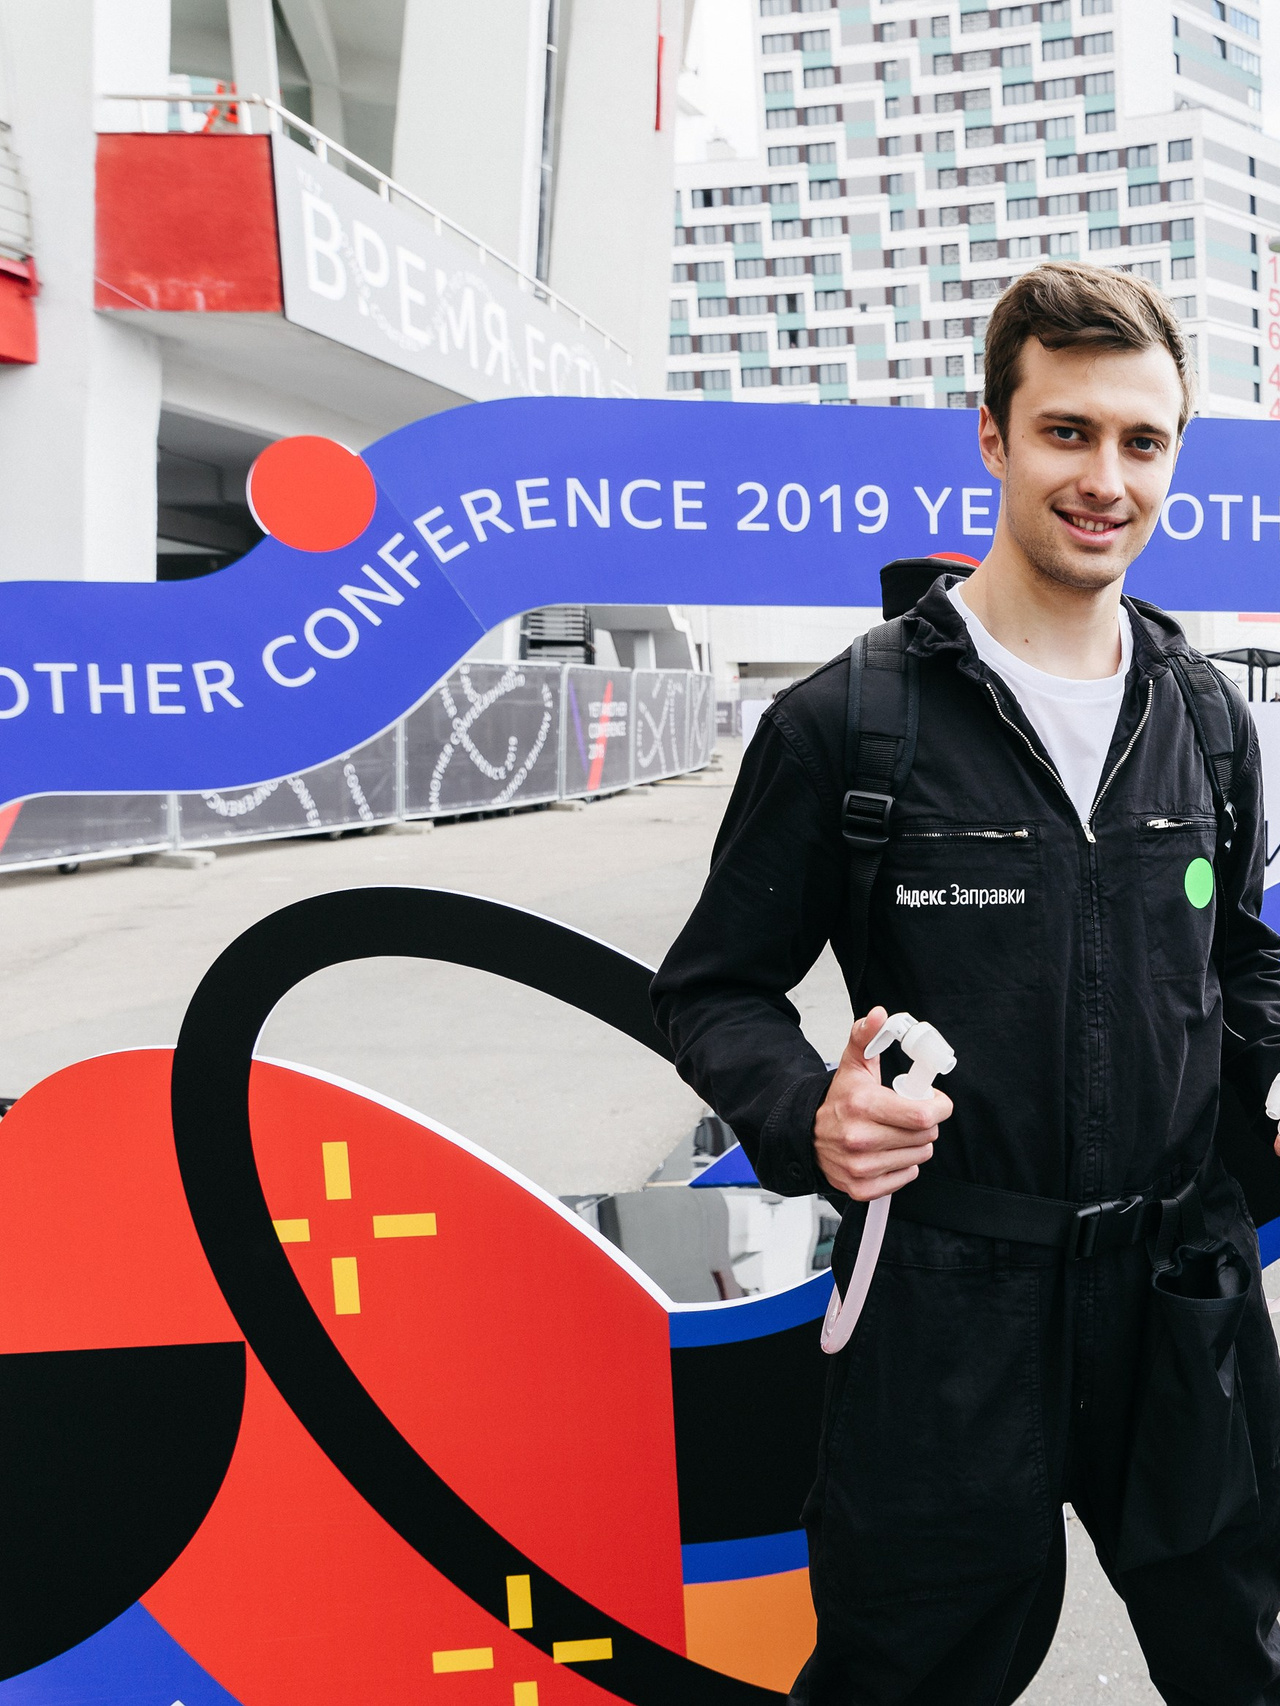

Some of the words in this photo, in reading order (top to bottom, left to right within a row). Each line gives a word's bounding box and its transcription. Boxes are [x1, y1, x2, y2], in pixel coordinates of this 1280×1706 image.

[302, 189, 511, 385] ВРЕМЯ
[0, 660, 244, 719] OTHER
[262, 477, 708, 687] CONFERENCE
[737, 482, 889, 534] 2019
[896, 884, 947, 908] Яндекс
[950, 883, 1025, 908] Заправки
